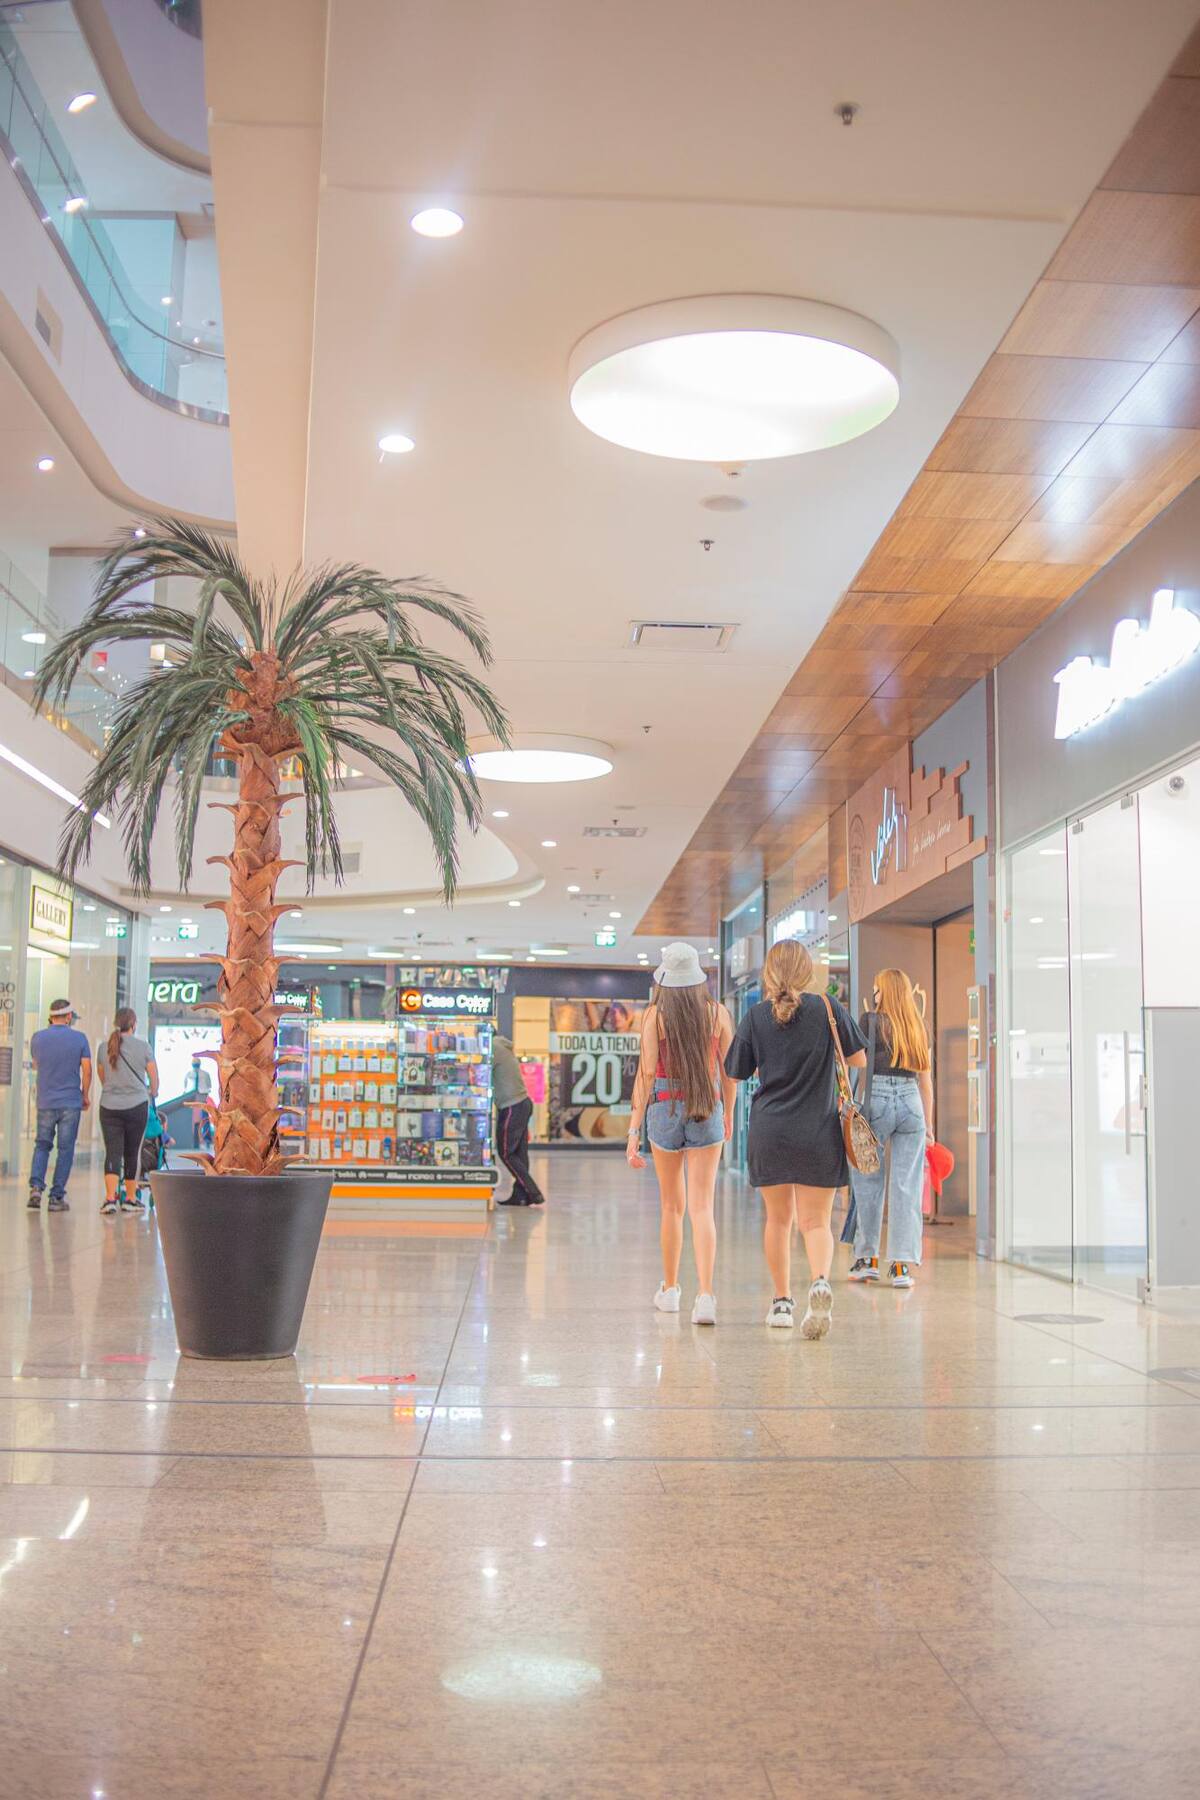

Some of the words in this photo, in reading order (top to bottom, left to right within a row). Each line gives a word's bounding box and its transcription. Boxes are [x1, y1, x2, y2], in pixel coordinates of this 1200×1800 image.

[36, 899, 67, 928] GALLERY
[558, 1035, 587, 1050] TODA
[590, 1036, 603, 1051] LA
